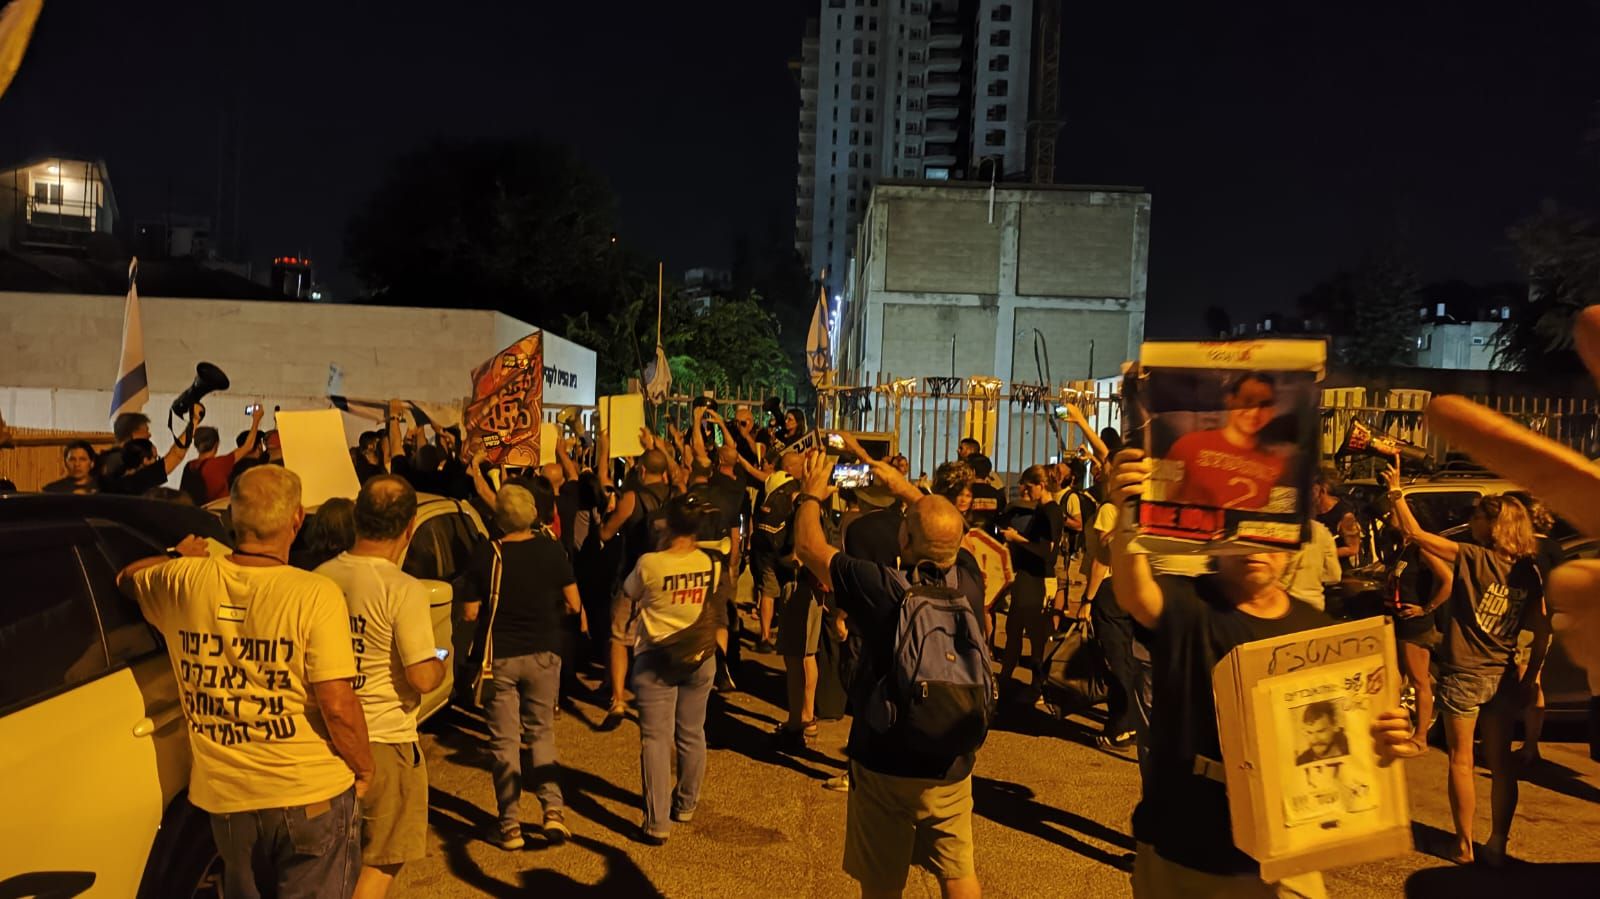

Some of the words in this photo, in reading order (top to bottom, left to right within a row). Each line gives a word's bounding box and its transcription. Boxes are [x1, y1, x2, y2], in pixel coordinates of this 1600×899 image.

[178, 629, 224, 657] כיפור
[232, 637, 294, 662] לוחמי
[250, 694, 284, 715] על
[255, 716, 296, 741] של
